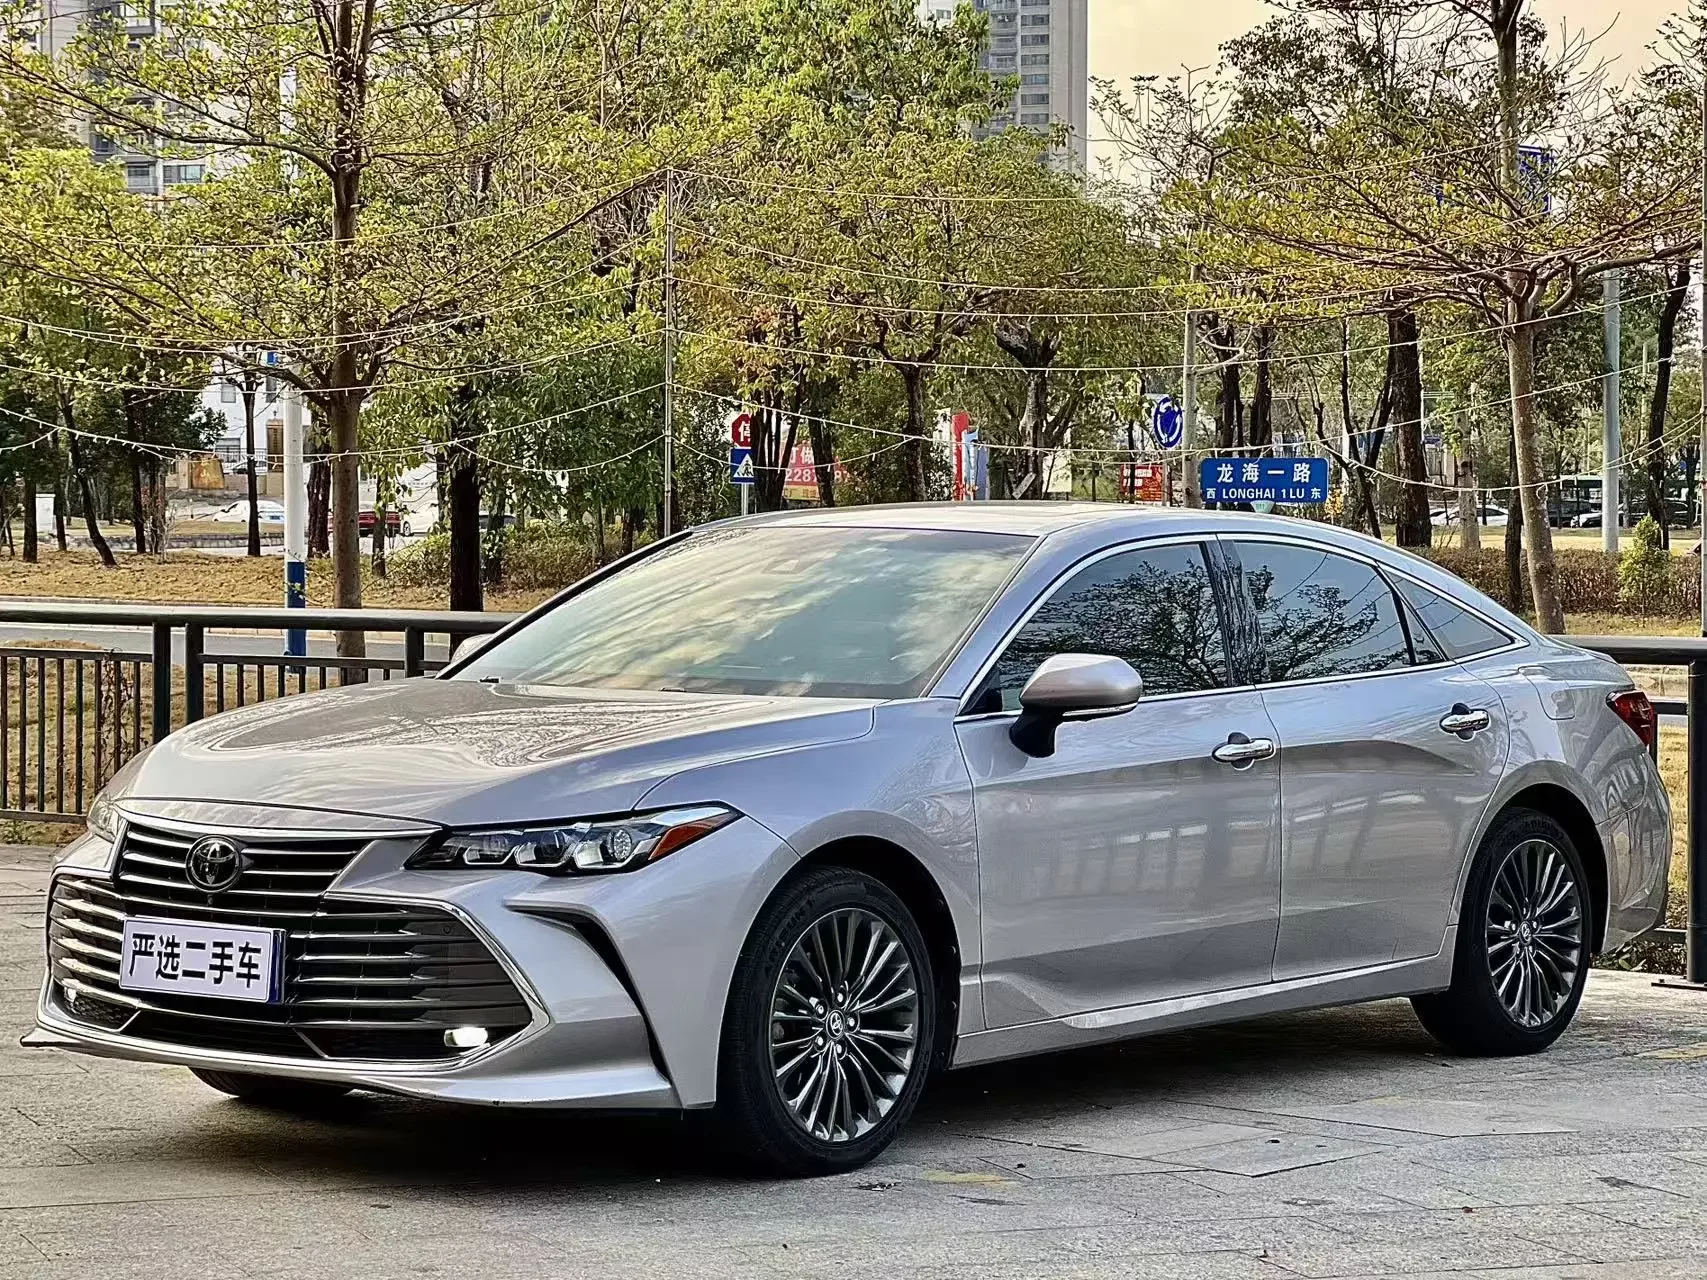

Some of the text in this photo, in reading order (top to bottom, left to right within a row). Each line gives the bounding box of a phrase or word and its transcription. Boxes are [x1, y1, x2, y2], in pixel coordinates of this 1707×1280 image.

[1217, 463, 1311, 483] 龙海一路
[1206, 488, 1217, 499] 西
[1222, 488, 1275, 499] LONGHAI
[1311, 488, 1321, 499] 东
[129, 933, 262, 988] 严选二手车
